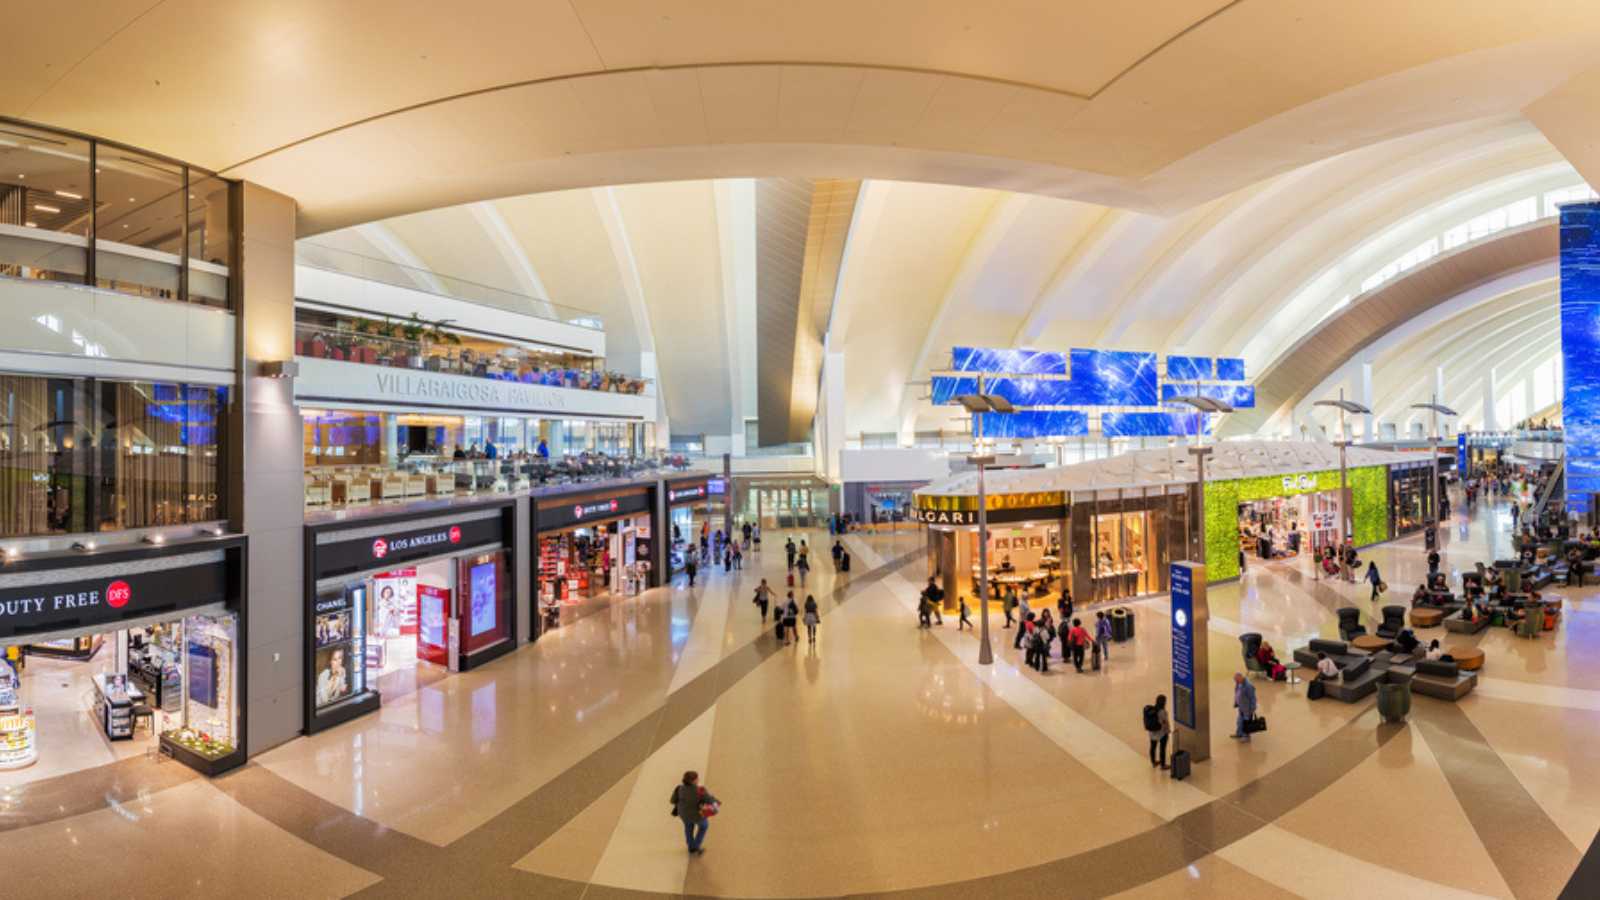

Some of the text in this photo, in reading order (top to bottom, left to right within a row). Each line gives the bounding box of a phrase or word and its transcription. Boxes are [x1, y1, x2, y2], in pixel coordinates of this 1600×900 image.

[376, 373, 500, 402] VILLARAIGOSA
[389, 539, 408, 551] LOS
[409, 532, 448, 547] ANGELES
[53, 590, 100, 610] FREE
[108, 587, 130, 601] DFS
[315, 599, 347, 612] CHANEL
